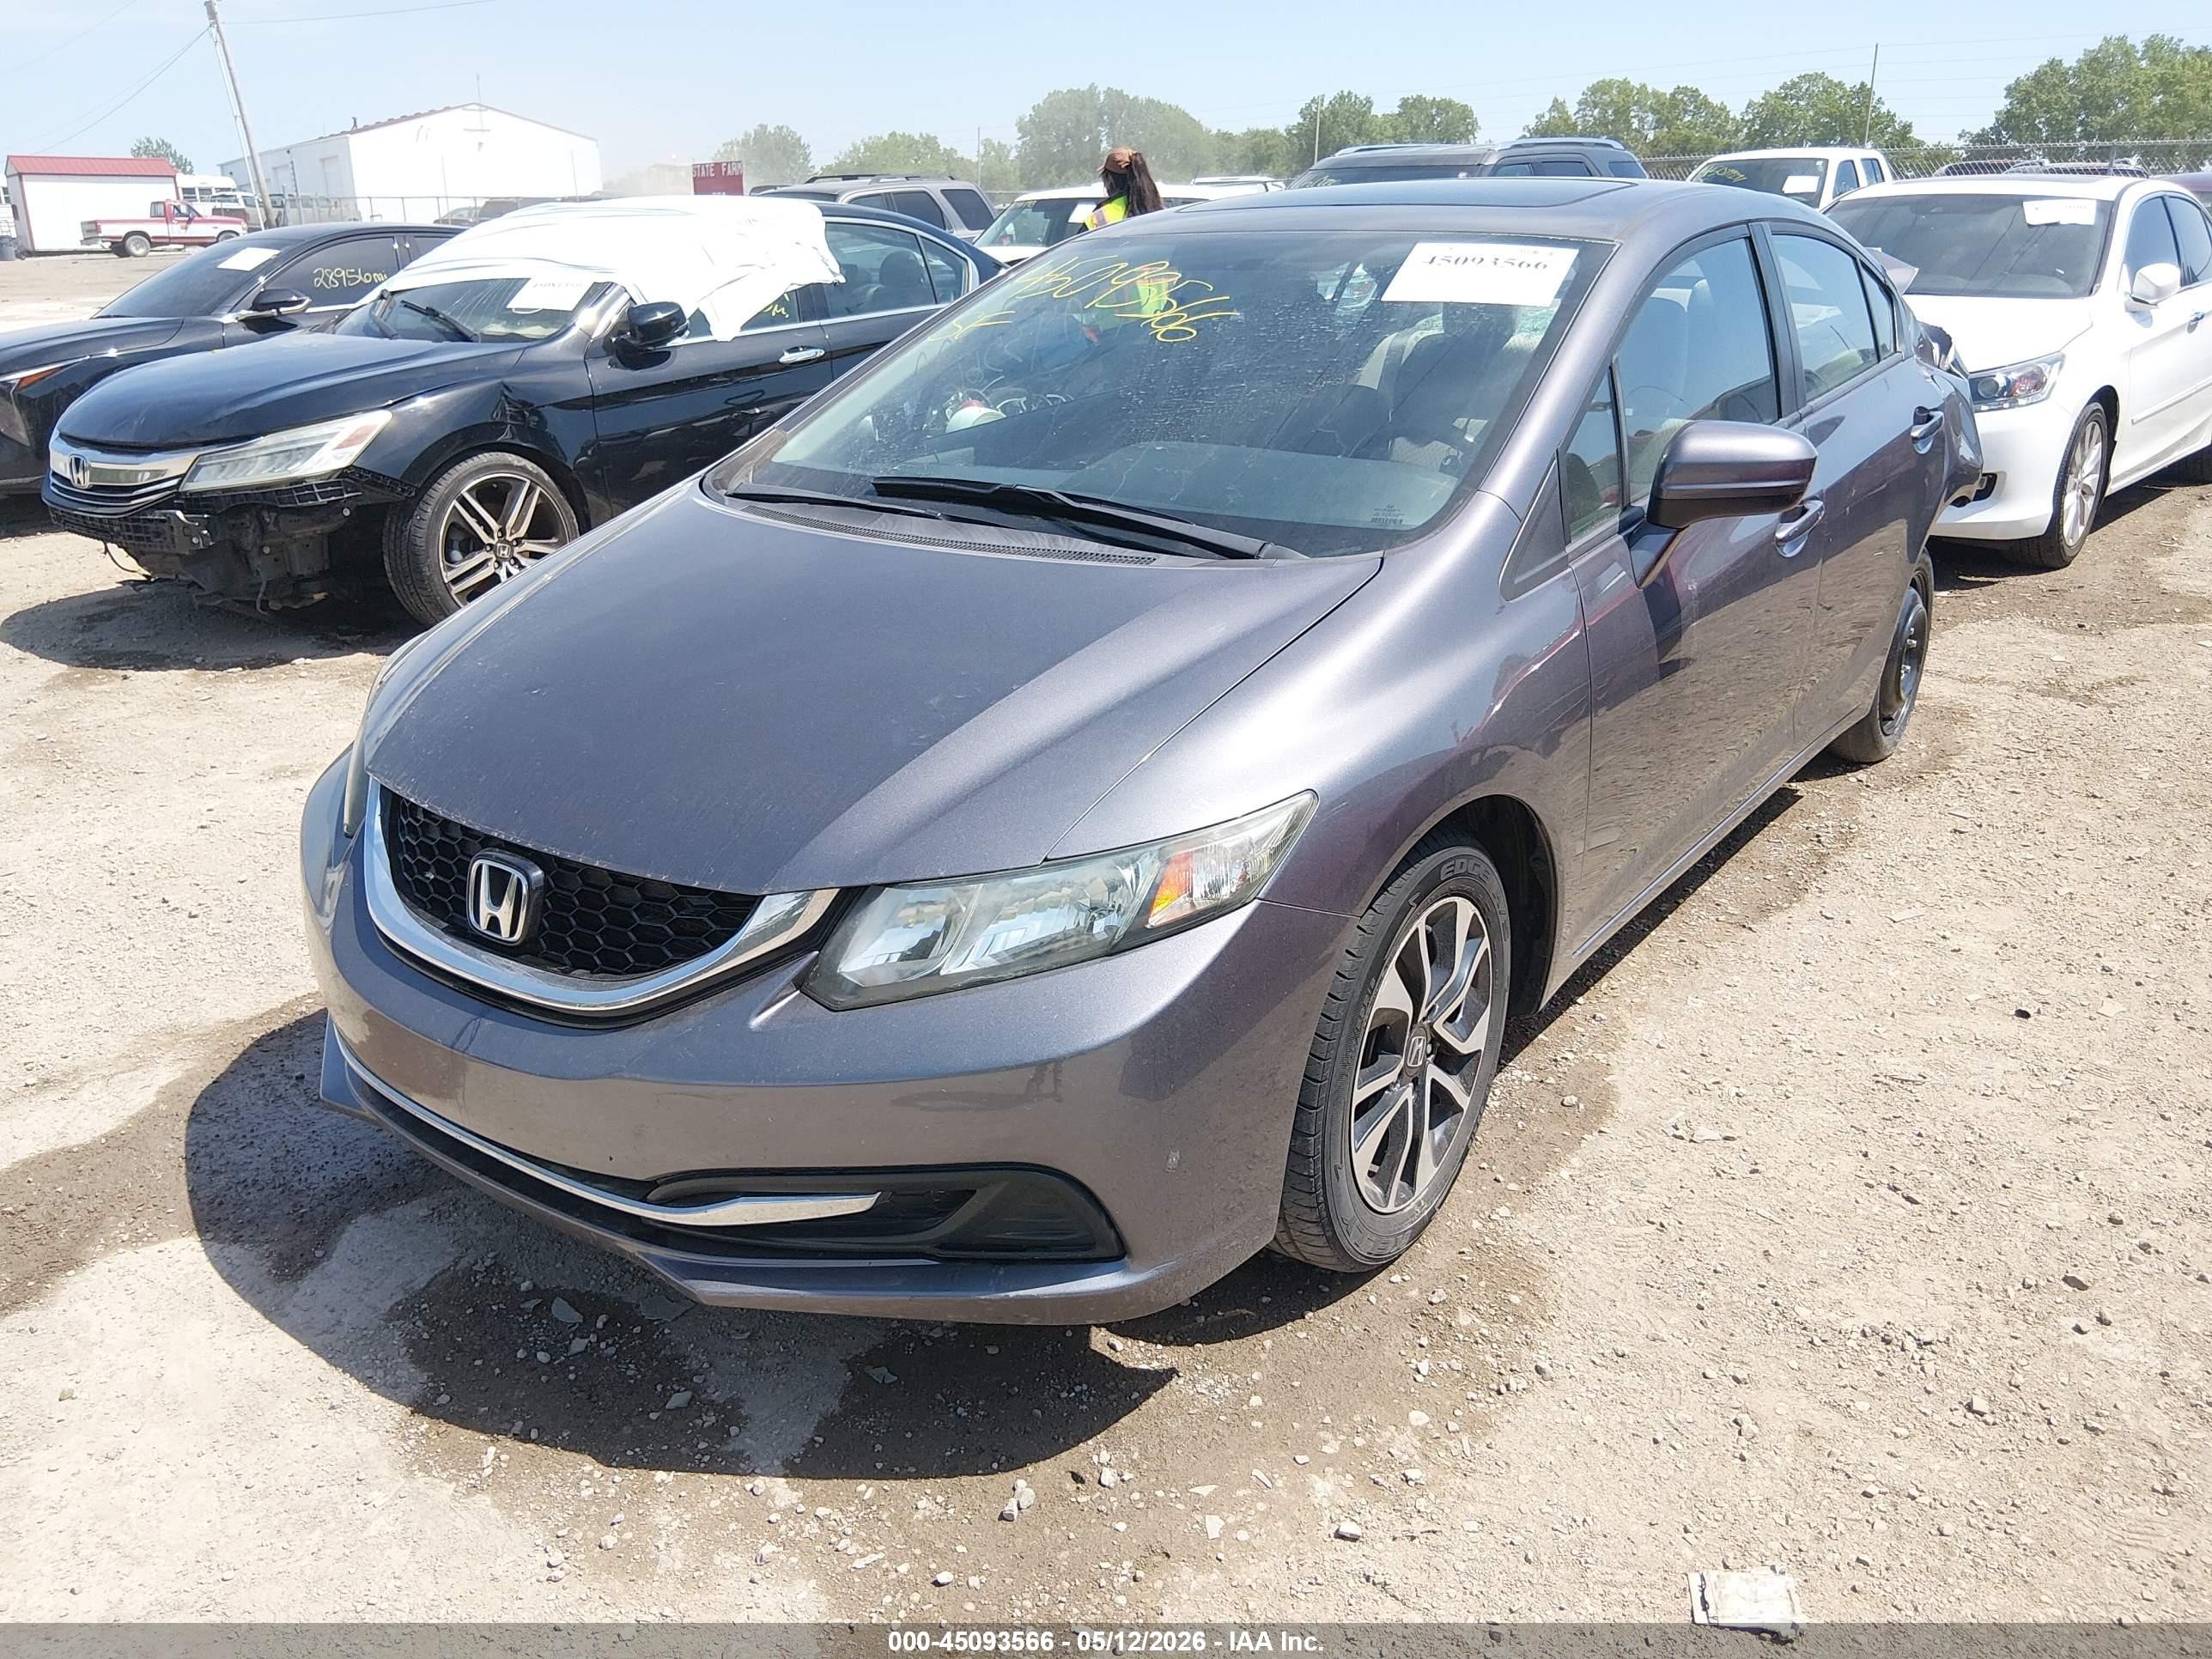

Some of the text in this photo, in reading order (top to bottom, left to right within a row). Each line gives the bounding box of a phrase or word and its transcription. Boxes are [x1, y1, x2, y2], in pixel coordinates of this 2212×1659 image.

[692, 161, 743, 179] STATE FARM
[1440, 858, 1491, 884] EDGE
